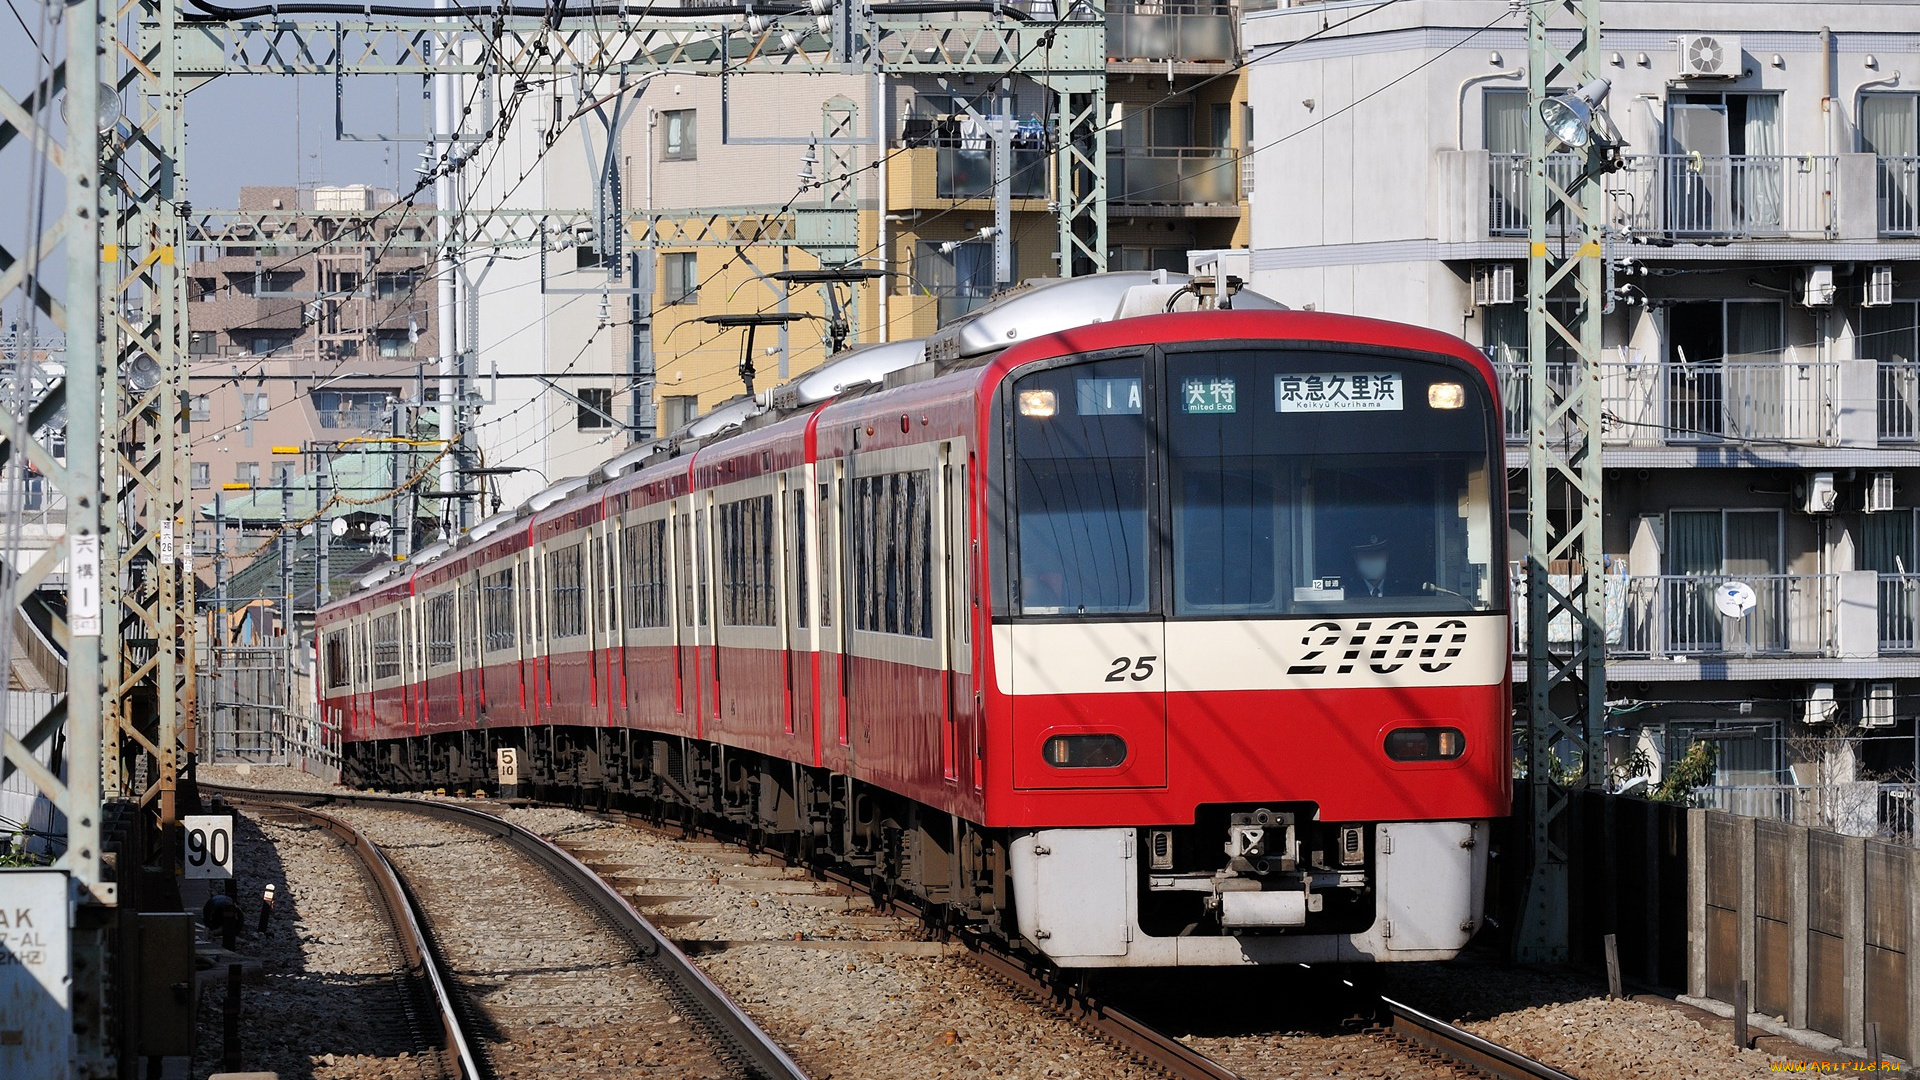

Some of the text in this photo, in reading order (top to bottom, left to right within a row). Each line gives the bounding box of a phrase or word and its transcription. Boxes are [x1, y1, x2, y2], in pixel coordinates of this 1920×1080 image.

[1181, 377, 1235, 404] 快特
[1281, 375, 1395, 401] 京急久里浜
[1217, 403, 1234, 411] Exp.
[1313, 581, 1322, 589] 12
[1286, 620, 1467, 675] 2100
[1105, 656, 1157, 682] 25
[502, 750, 513, 764] 5
[502, 766, 513, 775] 10
[188, 829, 229, 867] 90
